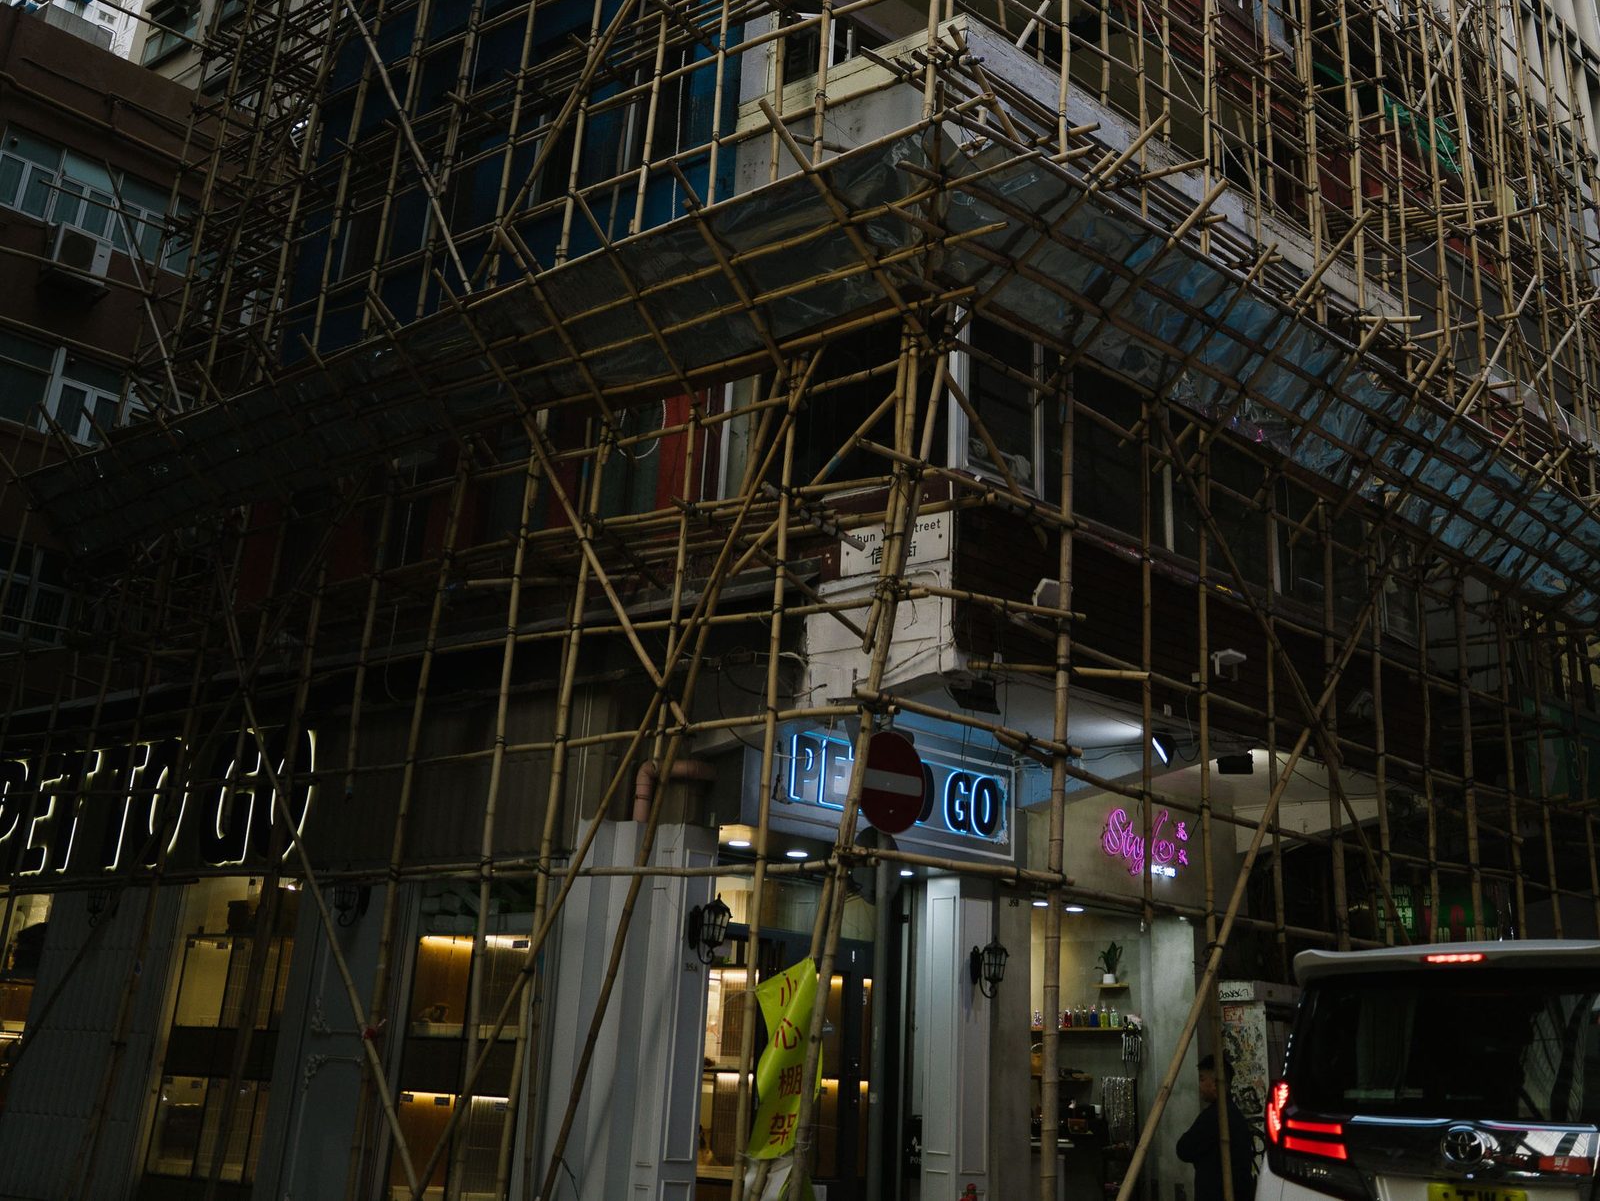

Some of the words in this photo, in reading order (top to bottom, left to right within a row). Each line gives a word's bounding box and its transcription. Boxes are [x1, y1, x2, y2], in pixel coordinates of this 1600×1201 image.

[915, 518, 941, 533] treet
[103, 736, 191, 871] TO
[203, 726, 318, 868] GO
[943, 770, 999, 837] GO
[769, 976, 802, 1145] 小心棚架
